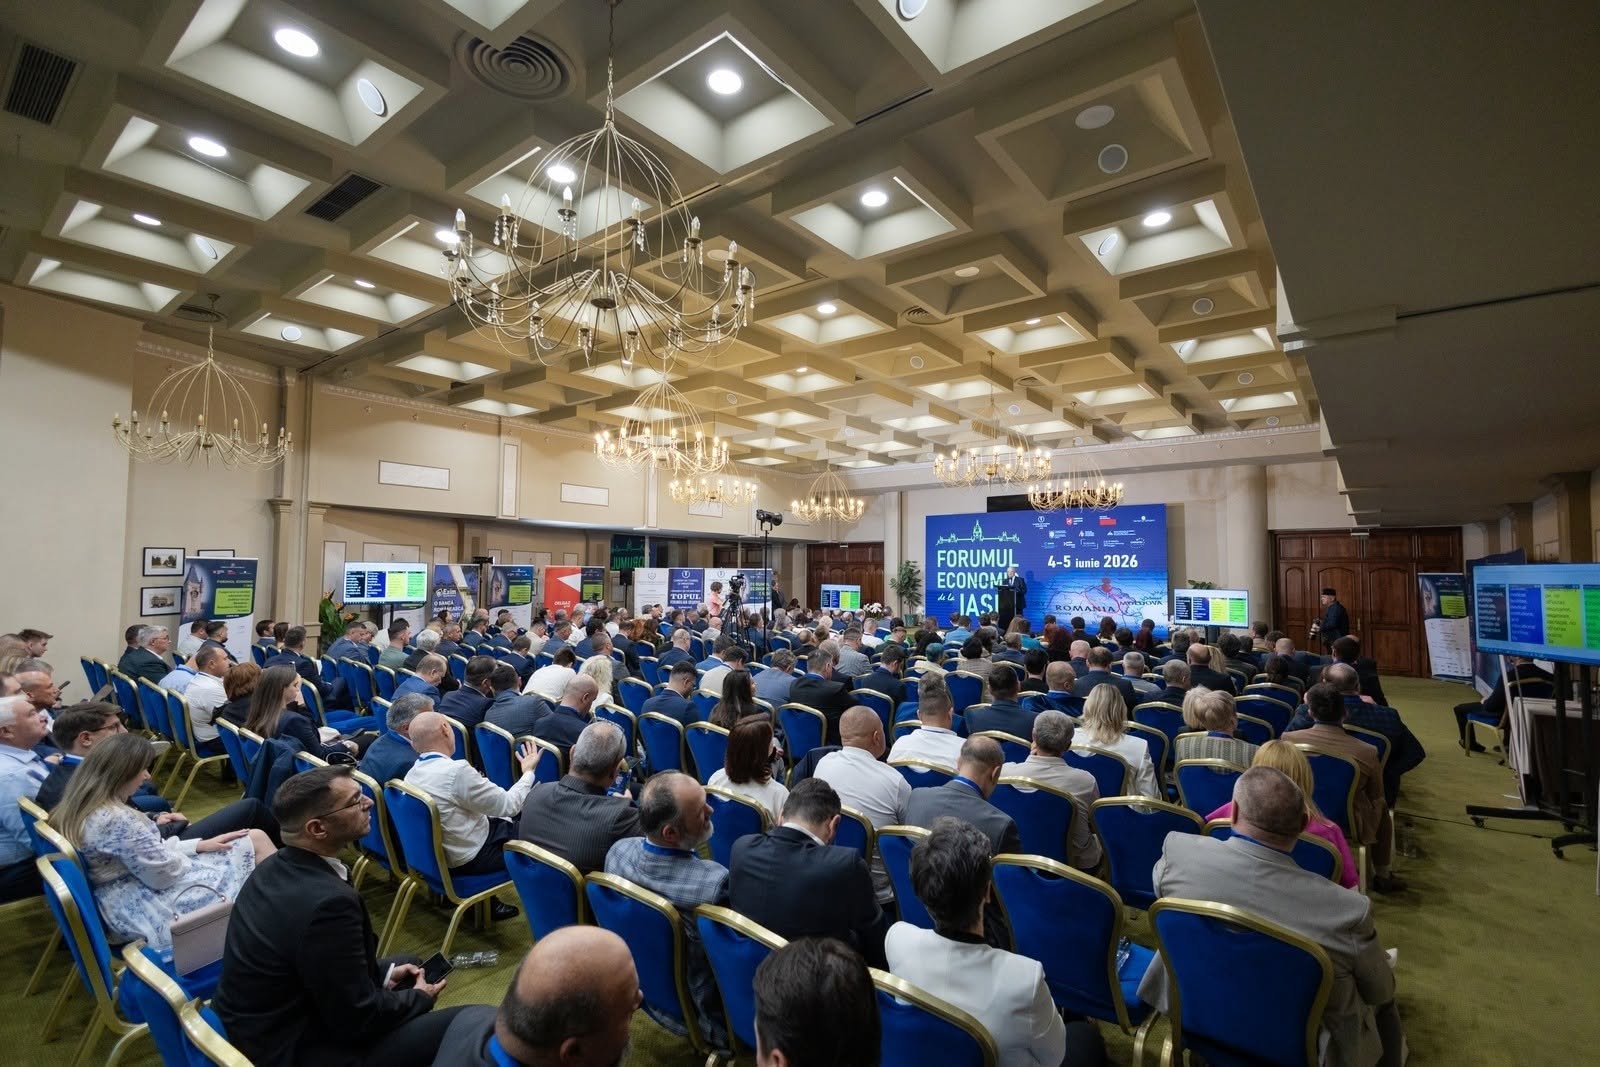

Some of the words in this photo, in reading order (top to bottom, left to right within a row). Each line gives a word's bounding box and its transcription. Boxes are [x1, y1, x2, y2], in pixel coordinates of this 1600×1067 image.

[937, 549, 1019, 568] FORUMUL
[1047, 554, 1071, 568] 4-5
[1075, 558, 1100, 568] iunie
[1103, 553, 1138, 568] 2026
[937, 572, 1019, 589] ECONOM
[937, 593, 946, 601] de
[947, 593, 955, 601] la
